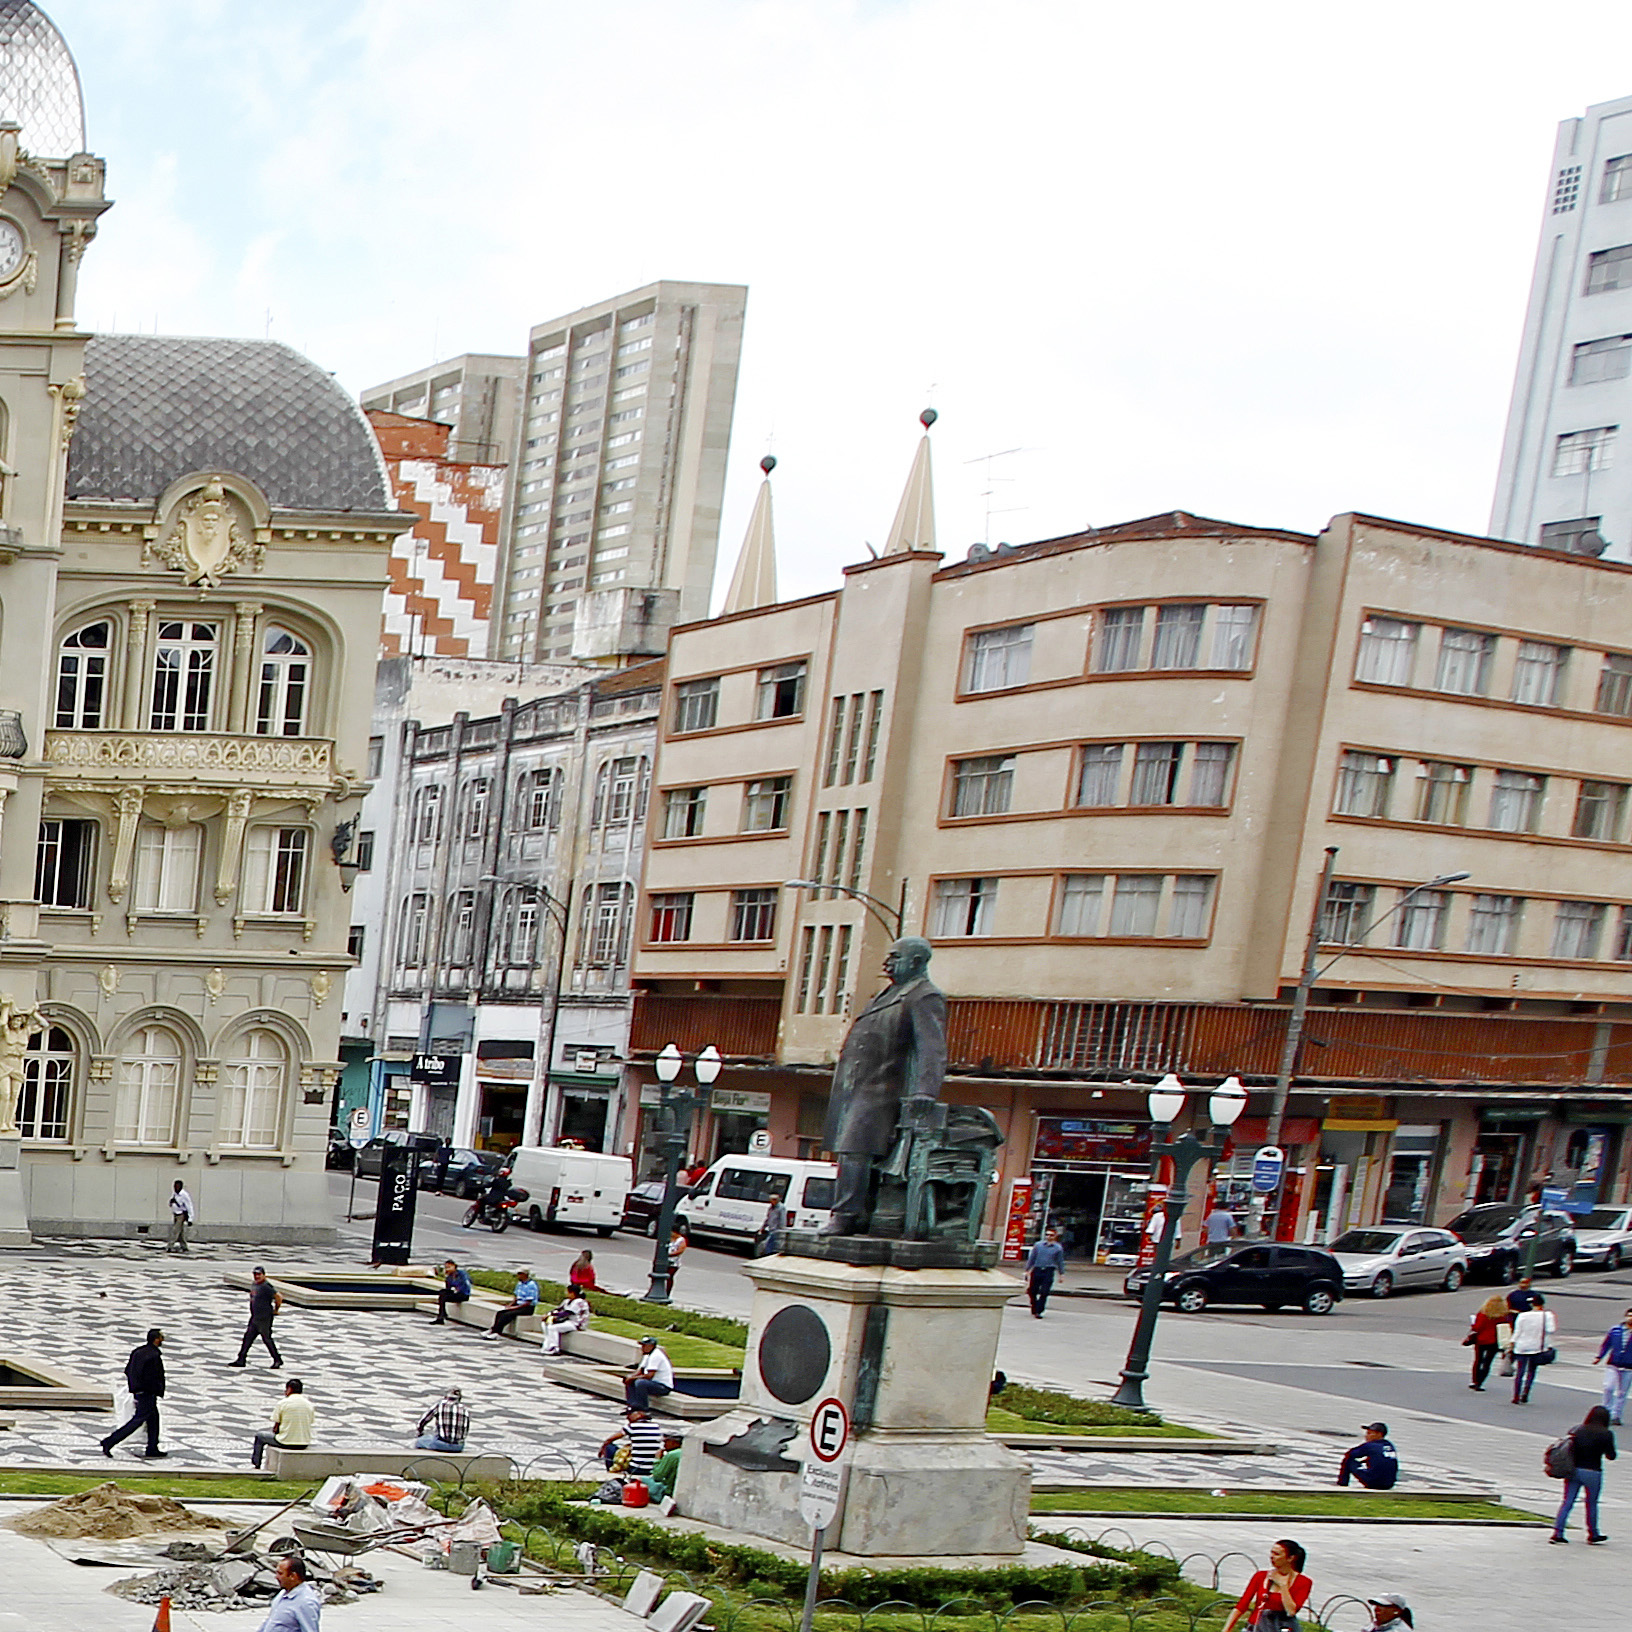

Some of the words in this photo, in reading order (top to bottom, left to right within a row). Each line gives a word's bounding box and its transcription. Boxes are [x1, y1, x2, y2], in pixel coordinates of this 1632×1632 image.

[357, 1112, 366, 1124] E
[756, 1134, 766, 1146] E
[820, 1410, 840, 1451] E
